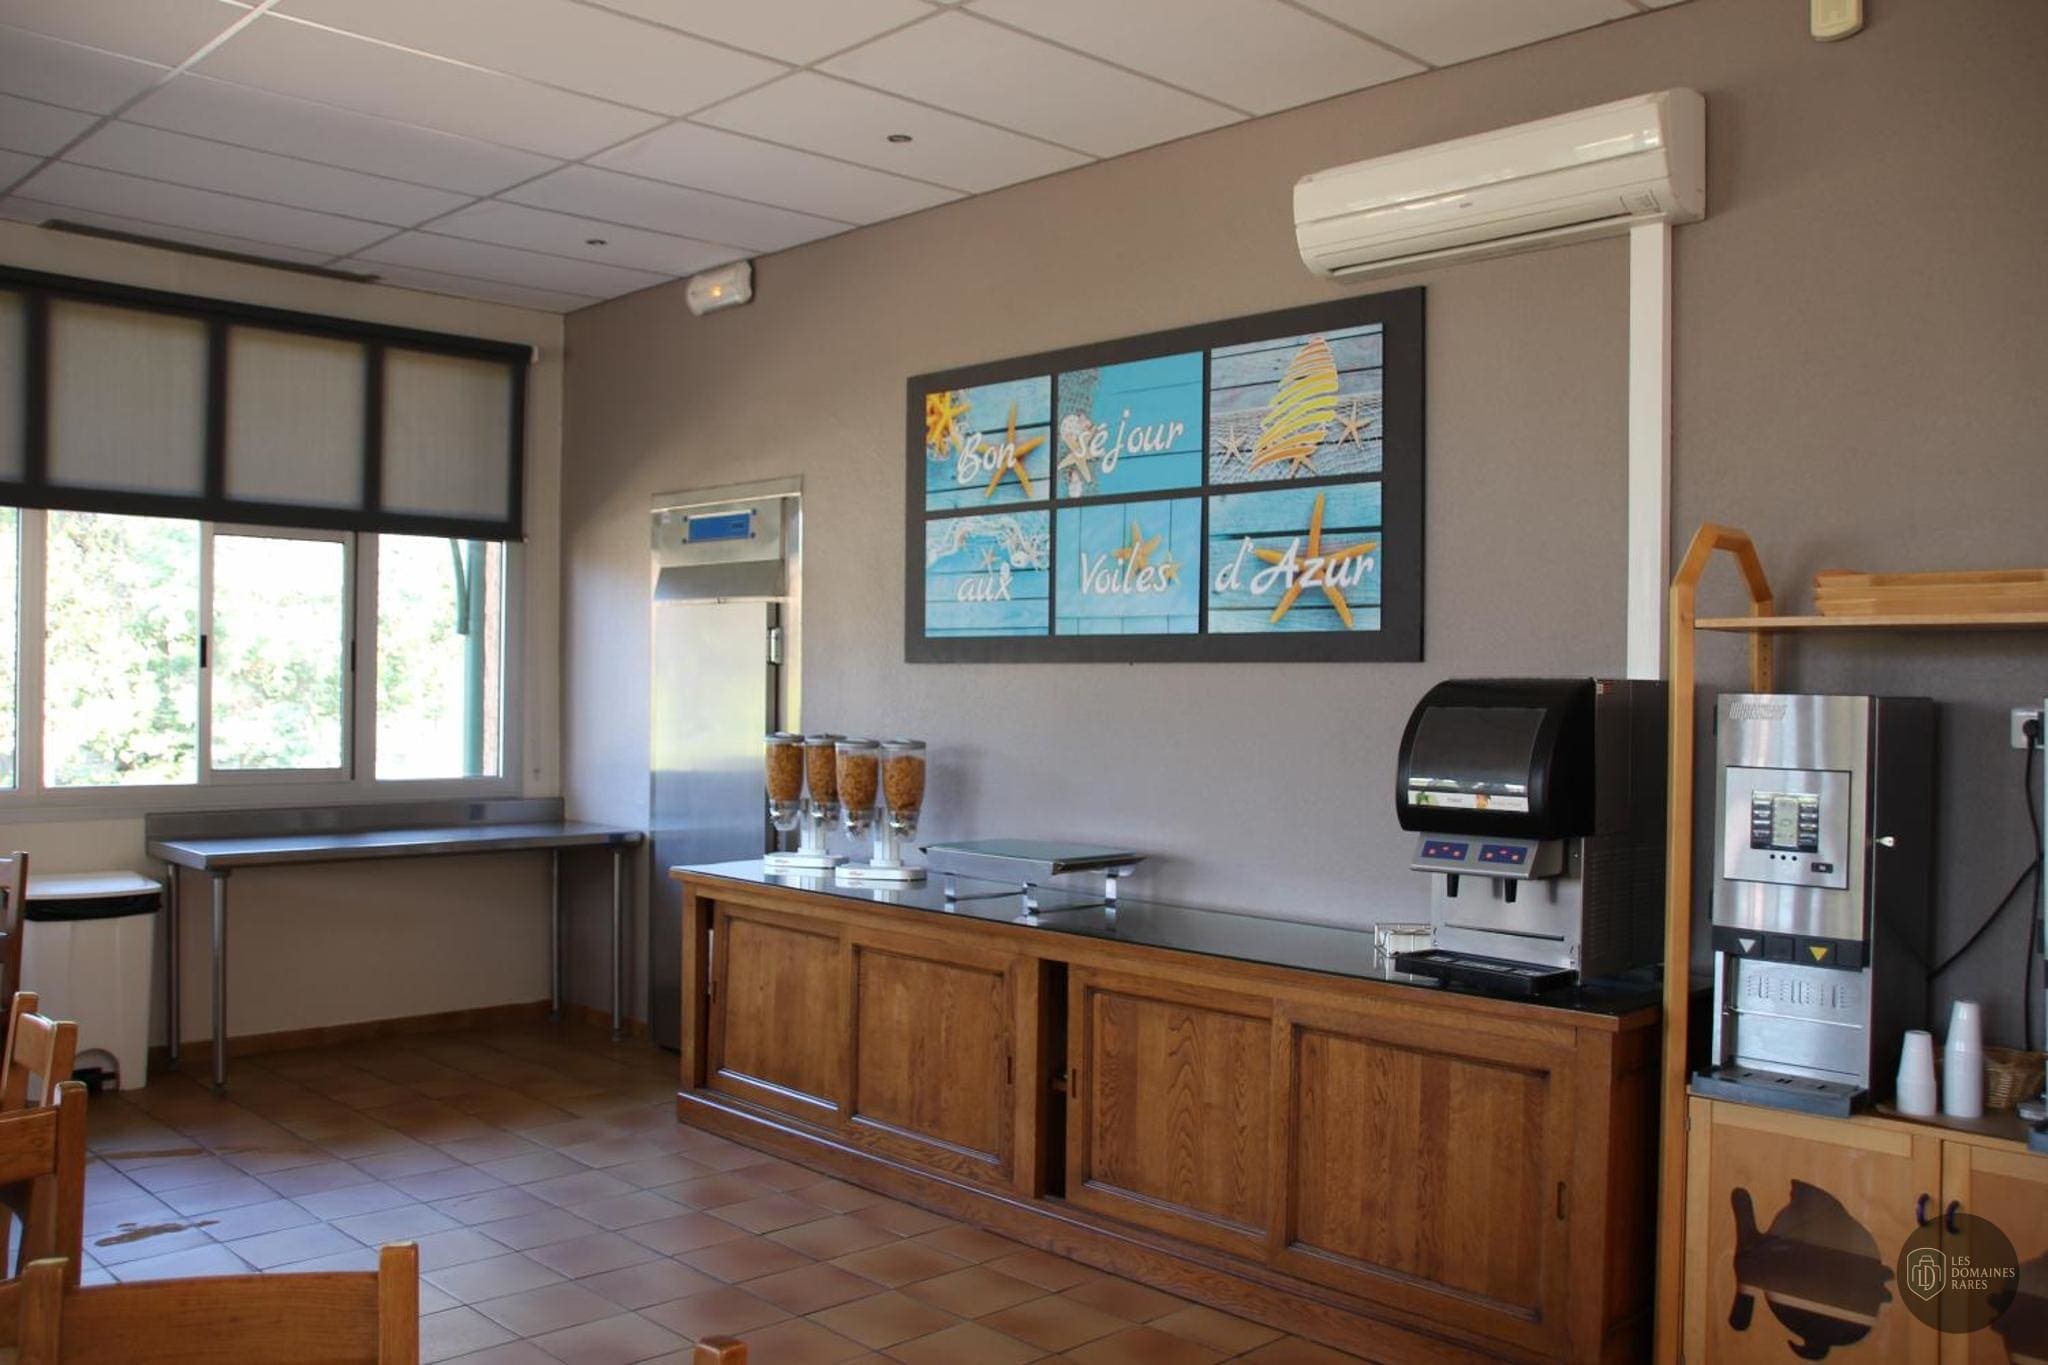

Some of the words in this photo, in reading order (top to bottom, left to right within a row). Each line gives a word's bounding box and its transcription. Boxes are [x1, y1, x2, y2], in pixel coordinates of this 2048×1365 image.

[957, 432, 1016, 484] Bon
[1074, 409, 1184, 474] séjour
[957, 575, 1013, 602] aux
[1081, 541, 1170, 594] Voiles
